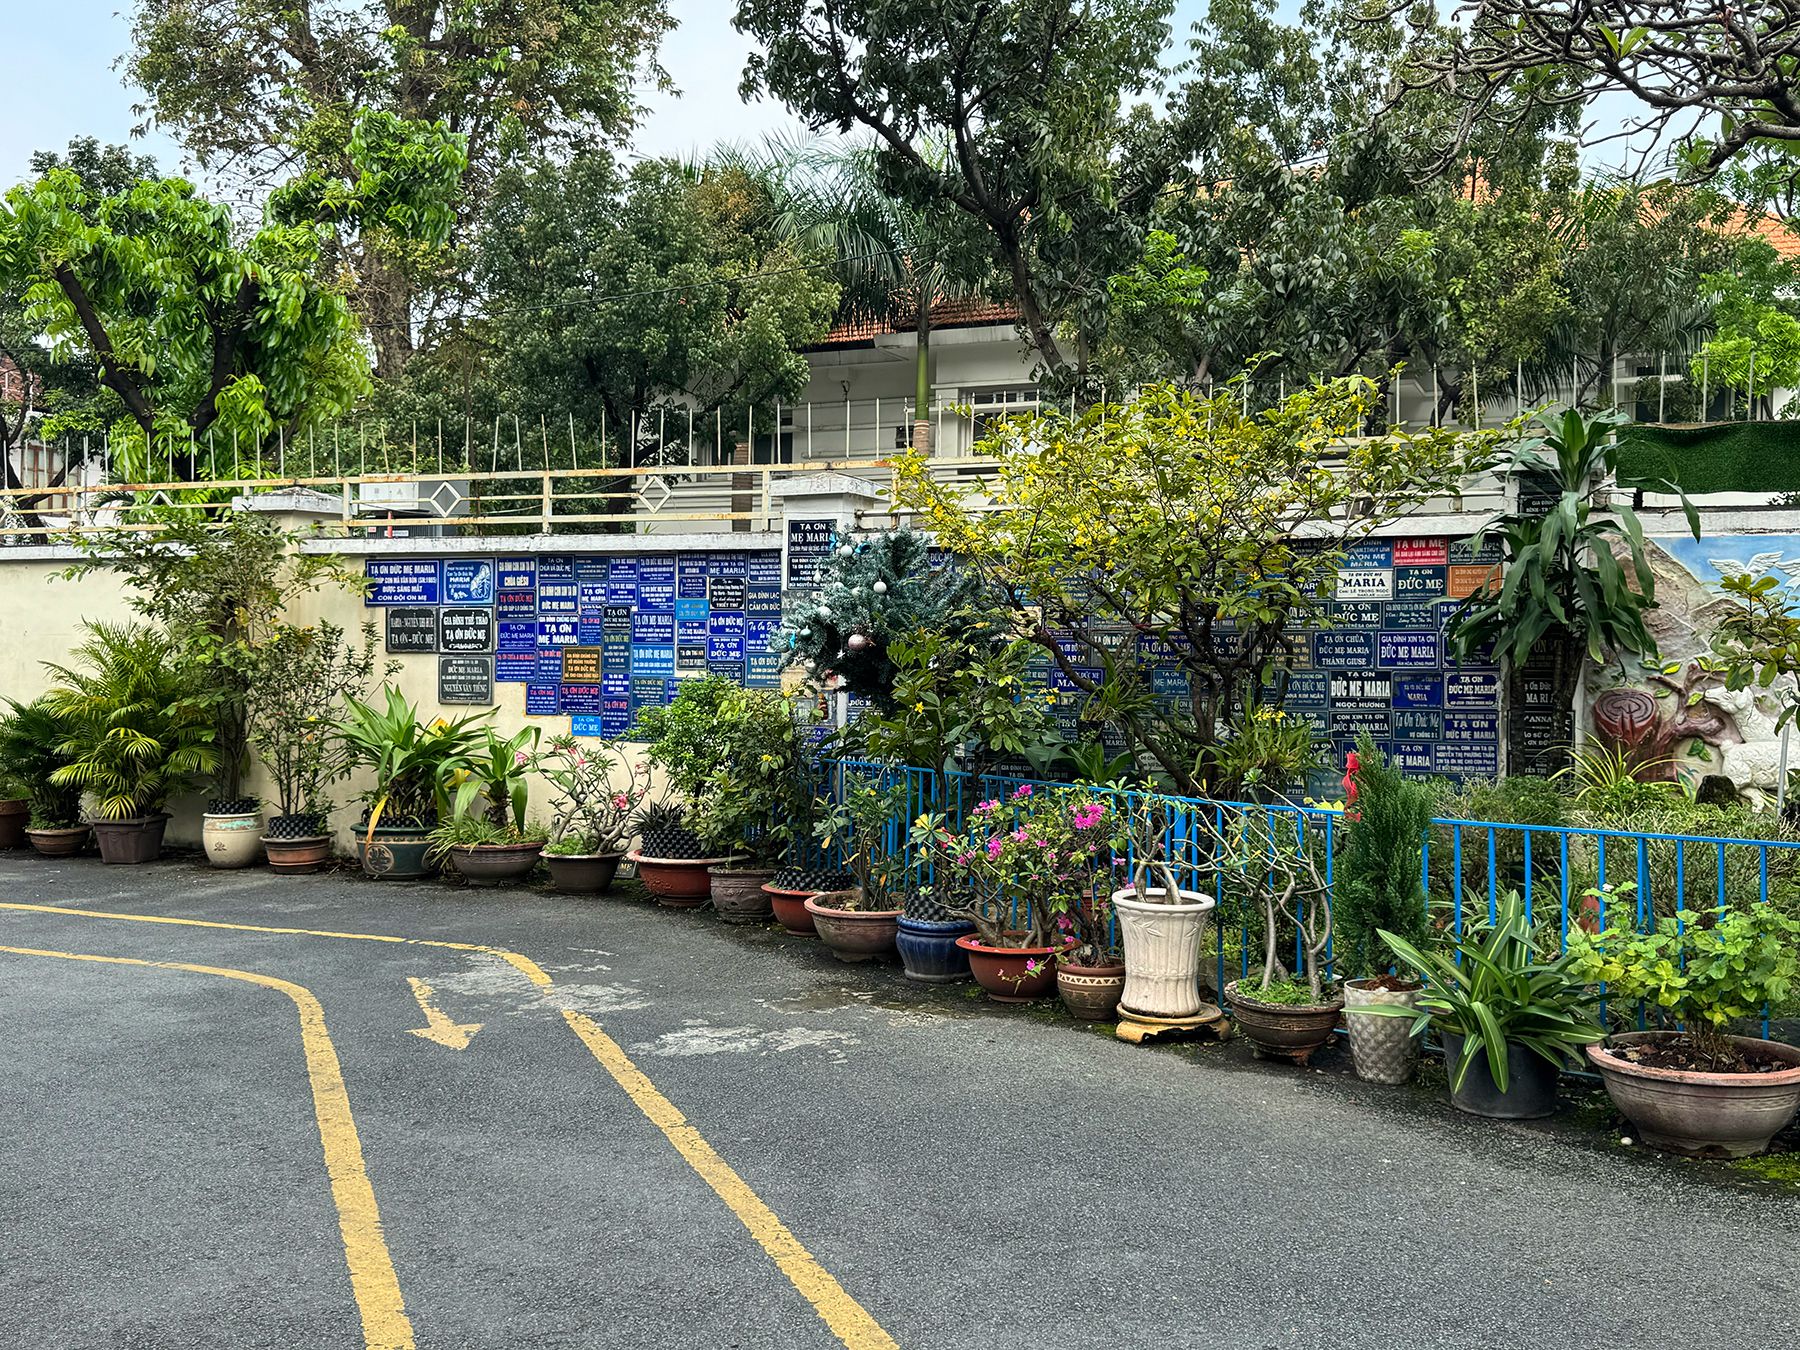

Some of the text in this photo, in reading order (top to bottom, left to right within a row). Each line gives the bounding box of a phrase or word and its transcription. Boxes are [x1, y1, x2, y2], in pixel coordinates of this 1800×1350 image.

[552, 635, 577, 643] MARIA
[1411, 646, 1435, 658] MARIA
[1364, 681, 1390, 697] MARIA
[1406, 755, 1430, 766] MARIA
